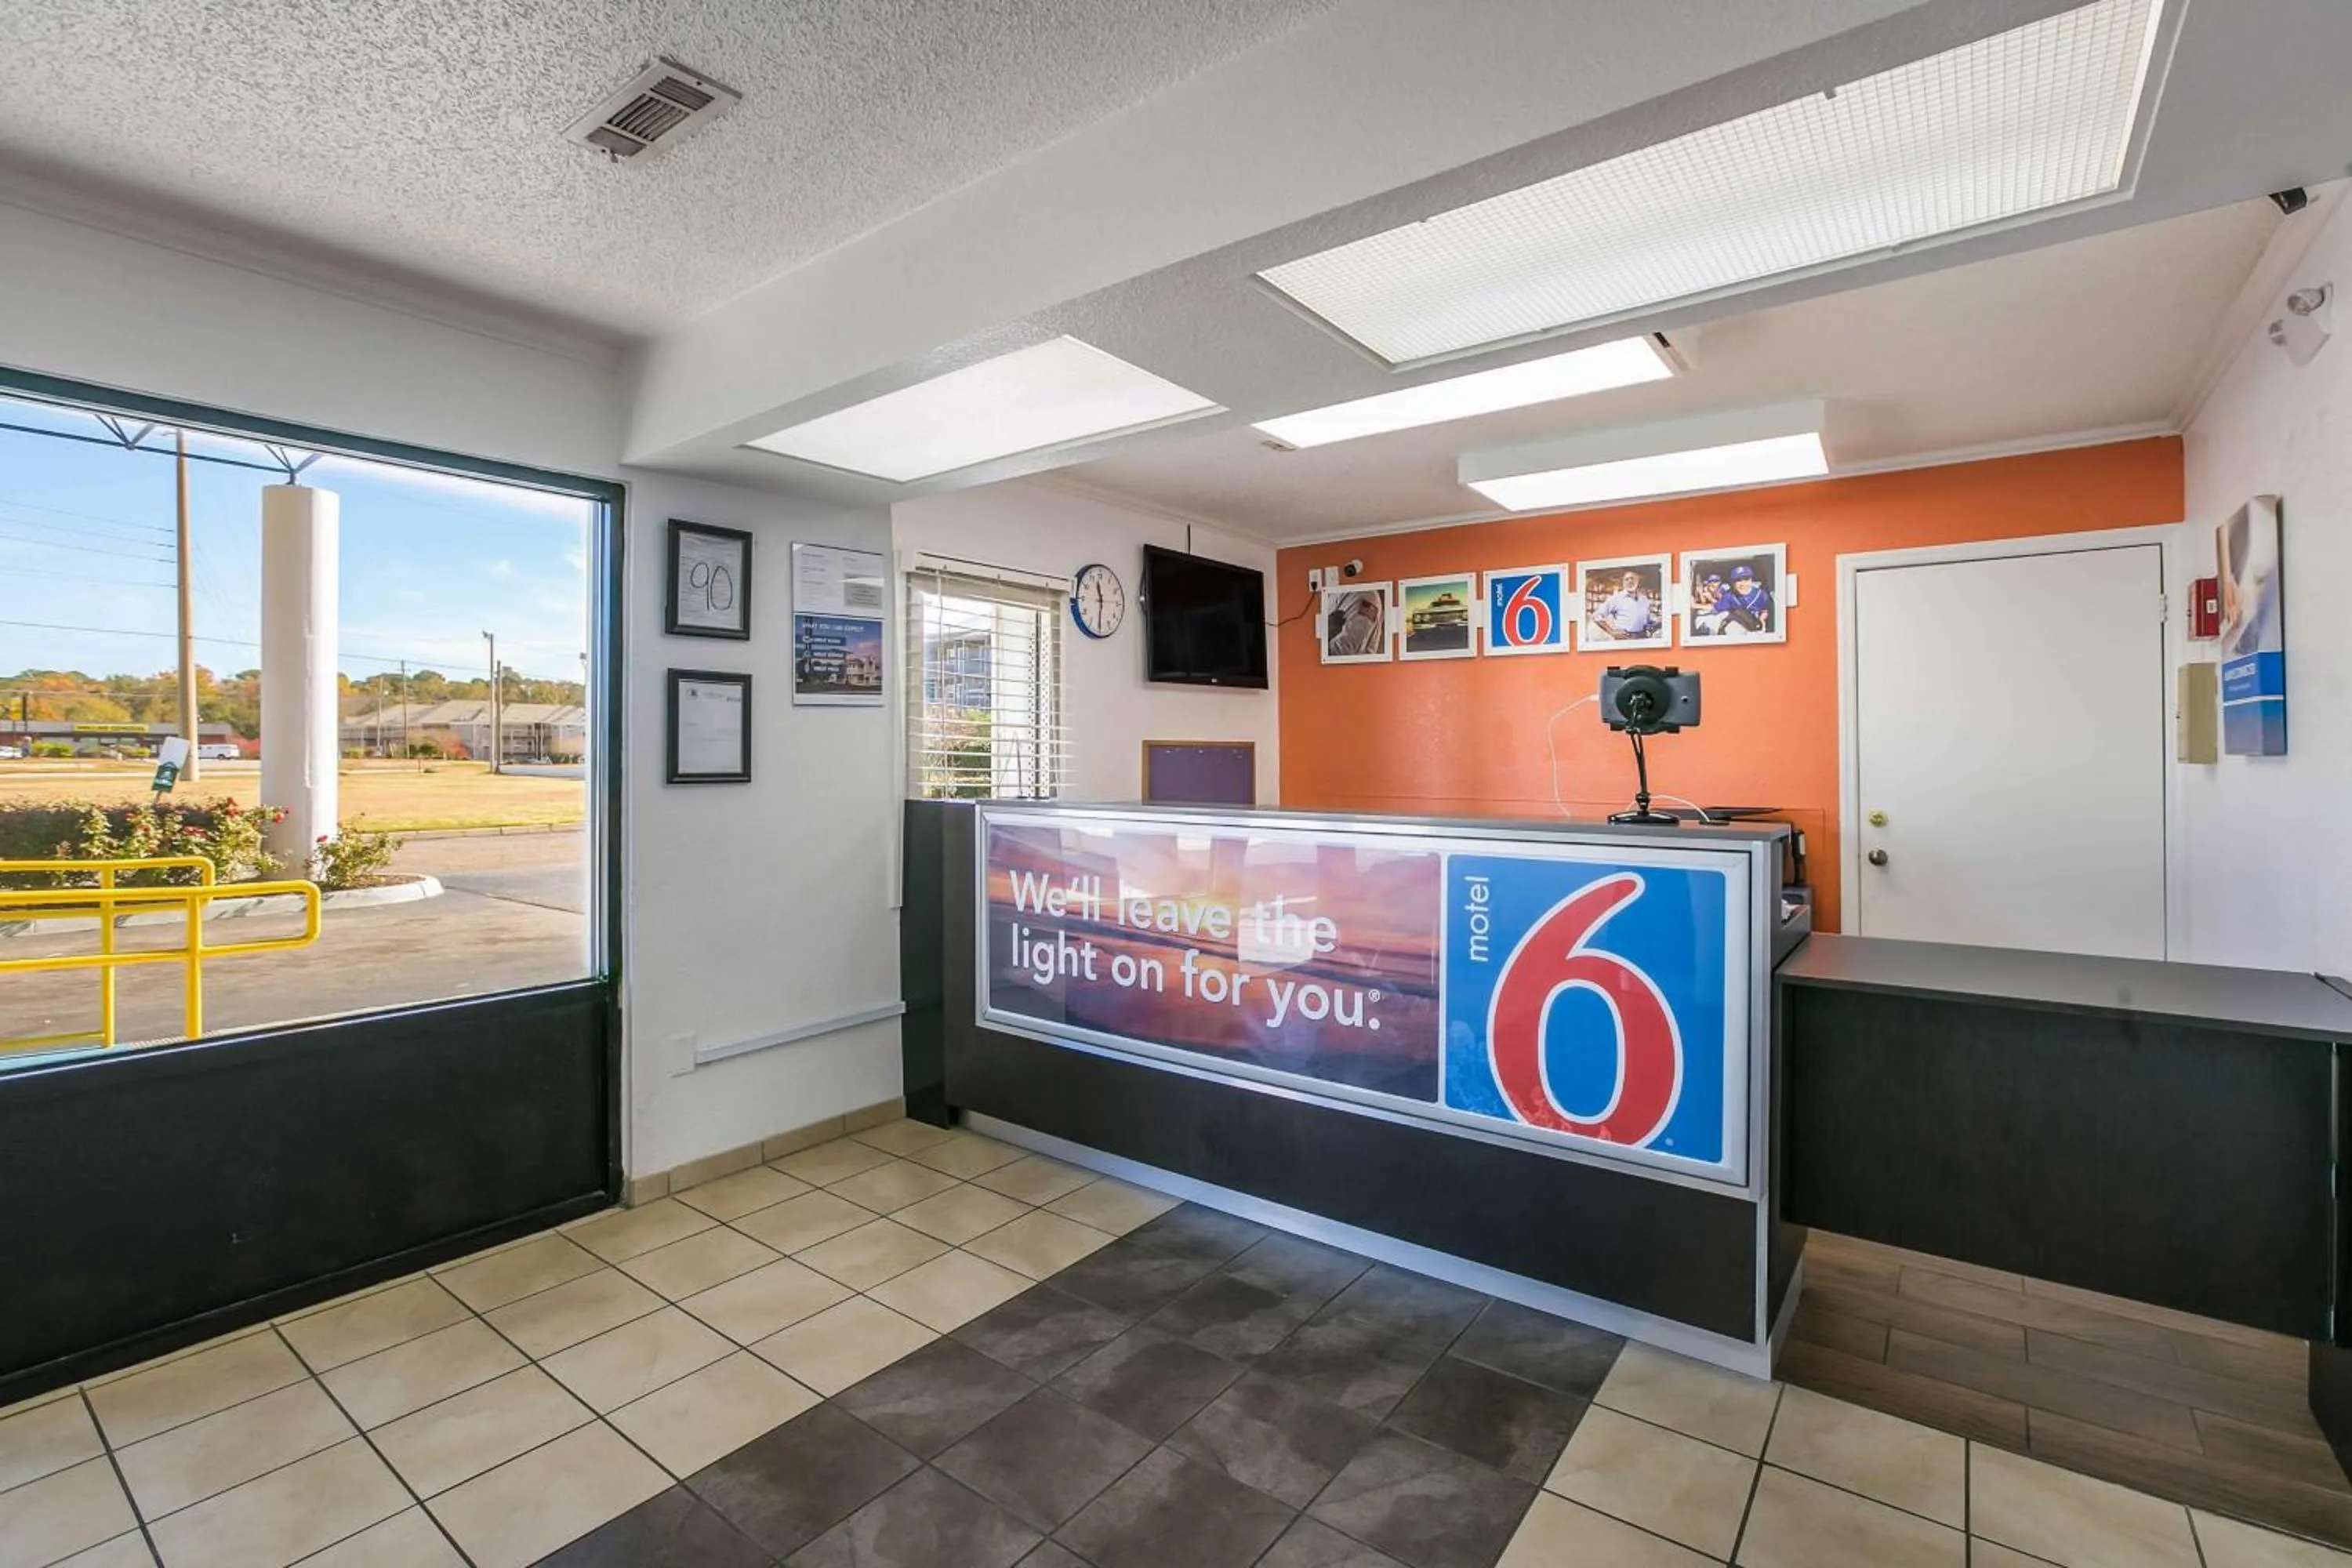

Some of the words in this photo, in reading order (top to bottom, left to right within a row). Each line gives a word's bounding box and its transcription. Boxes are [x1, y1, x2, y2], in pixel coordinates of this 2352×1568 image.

[690, 562, 733, 611] 90
[1502, 575, 1552, 647] 6
[1009, 870, 1100, 922] We'll
[1119, 880, 1232, 938] leave
[1254, 895, 1338, 953] the
[1465, 876, 1490, 962] motel
[1011, 924, 1098, 985] light
[1111, 953, 1163, 993] on
[1180, 949, 1250, 1006] for
[1486, 872, 1683, 1149] 6
